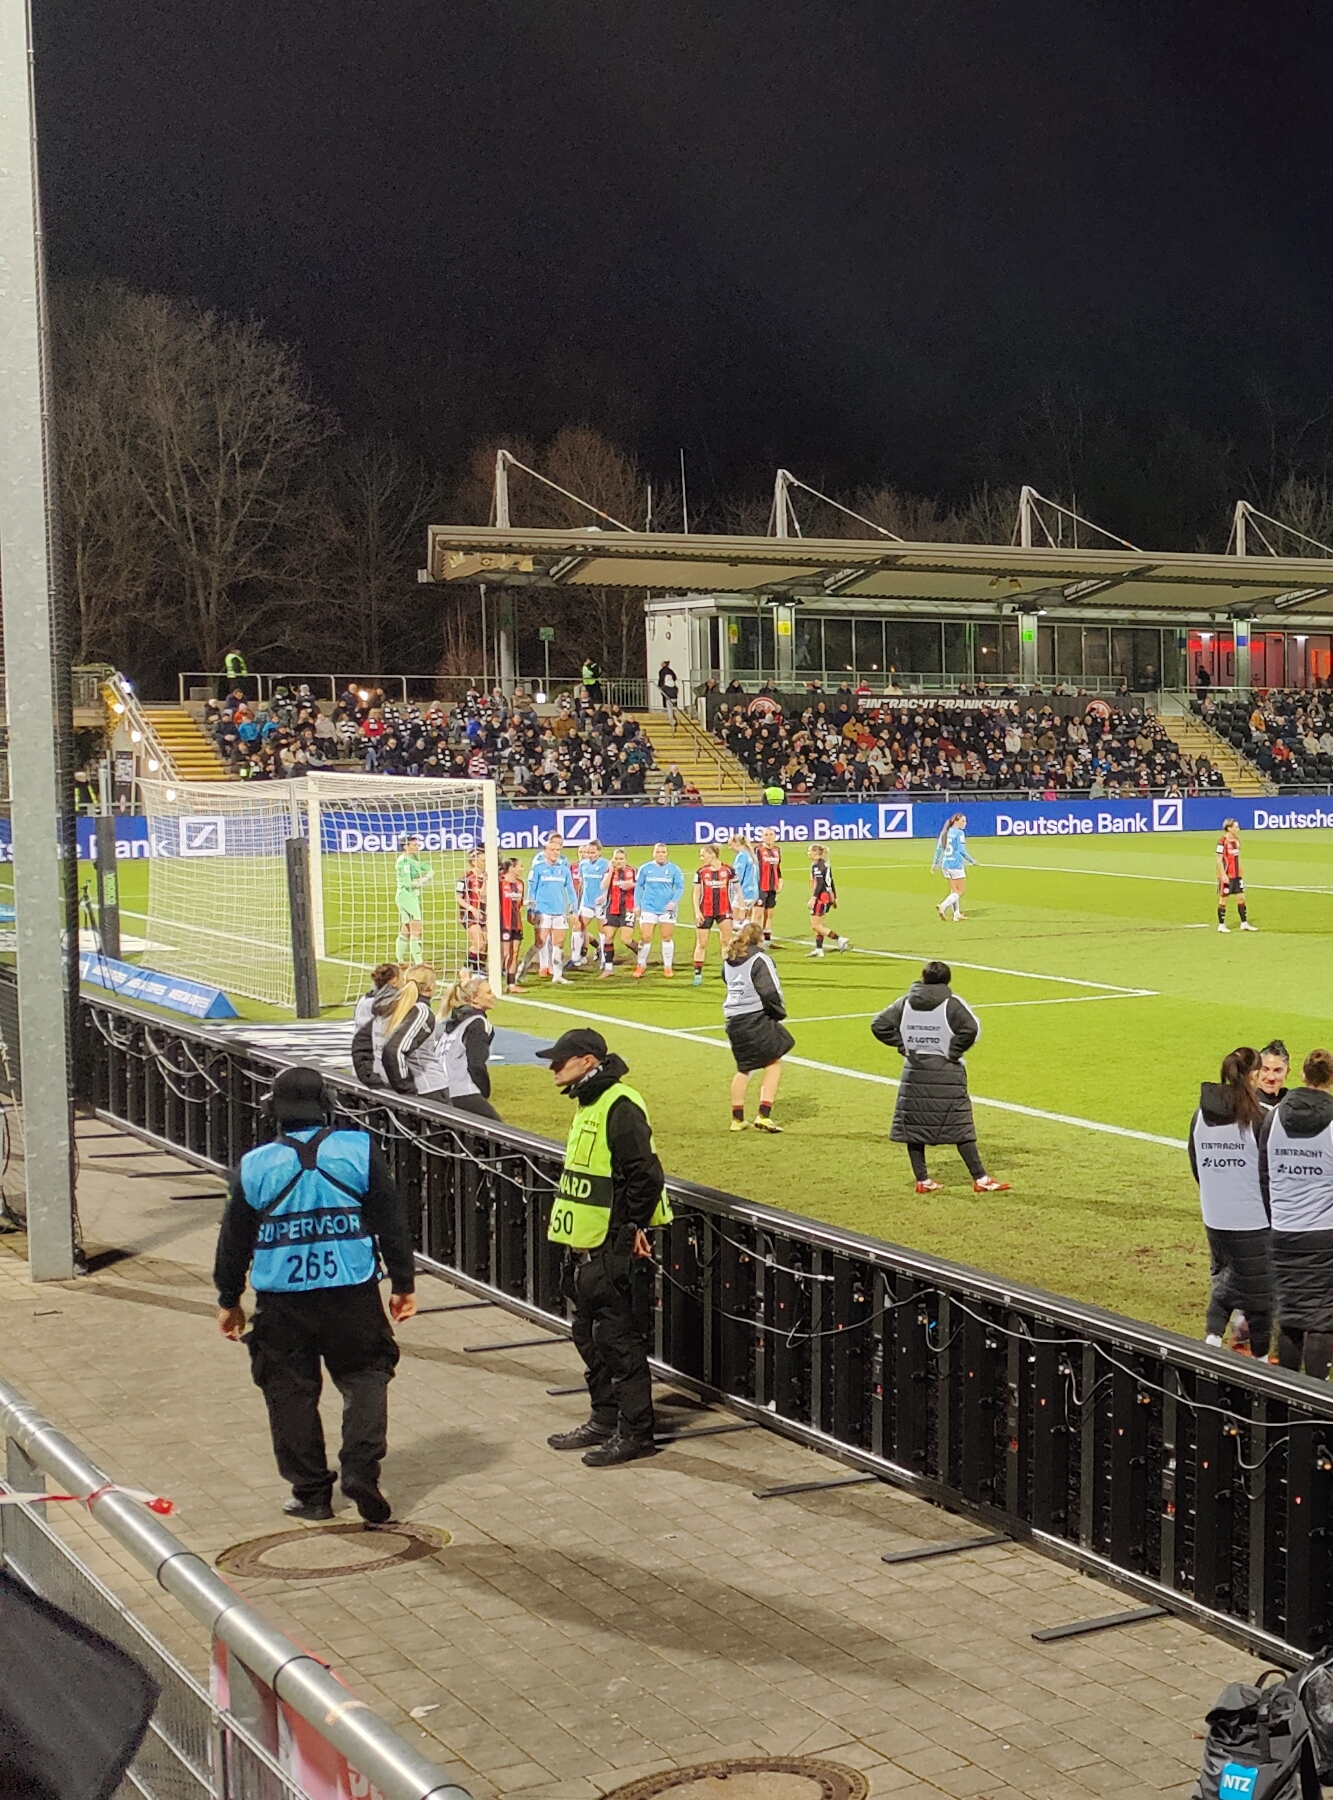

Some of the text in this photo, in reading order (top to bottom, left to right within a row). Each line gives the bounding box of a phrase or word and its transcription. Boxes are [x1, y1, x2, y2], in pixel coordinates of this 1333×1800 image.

[858, 698, 1018, 709] EINTRACHT FRANKFURT
[695, 817, 875, 844] Deutshe Bank
[996, 812, 1149, 836] Deutsche Bank
[341, 828, 475, 852] Deusche
[1201, 1142, 1246, 1151] EINTRACHT
[1213, 1158, 1246, 1168] LOTTO
[1288, 1164, 1323, 1176] LOTTO
[257, 1214, 361, 1243] SUPERVSOR
[287, 1250, 338, 1284] 265
[1222, 1775, 1251, 1793] NTZ
